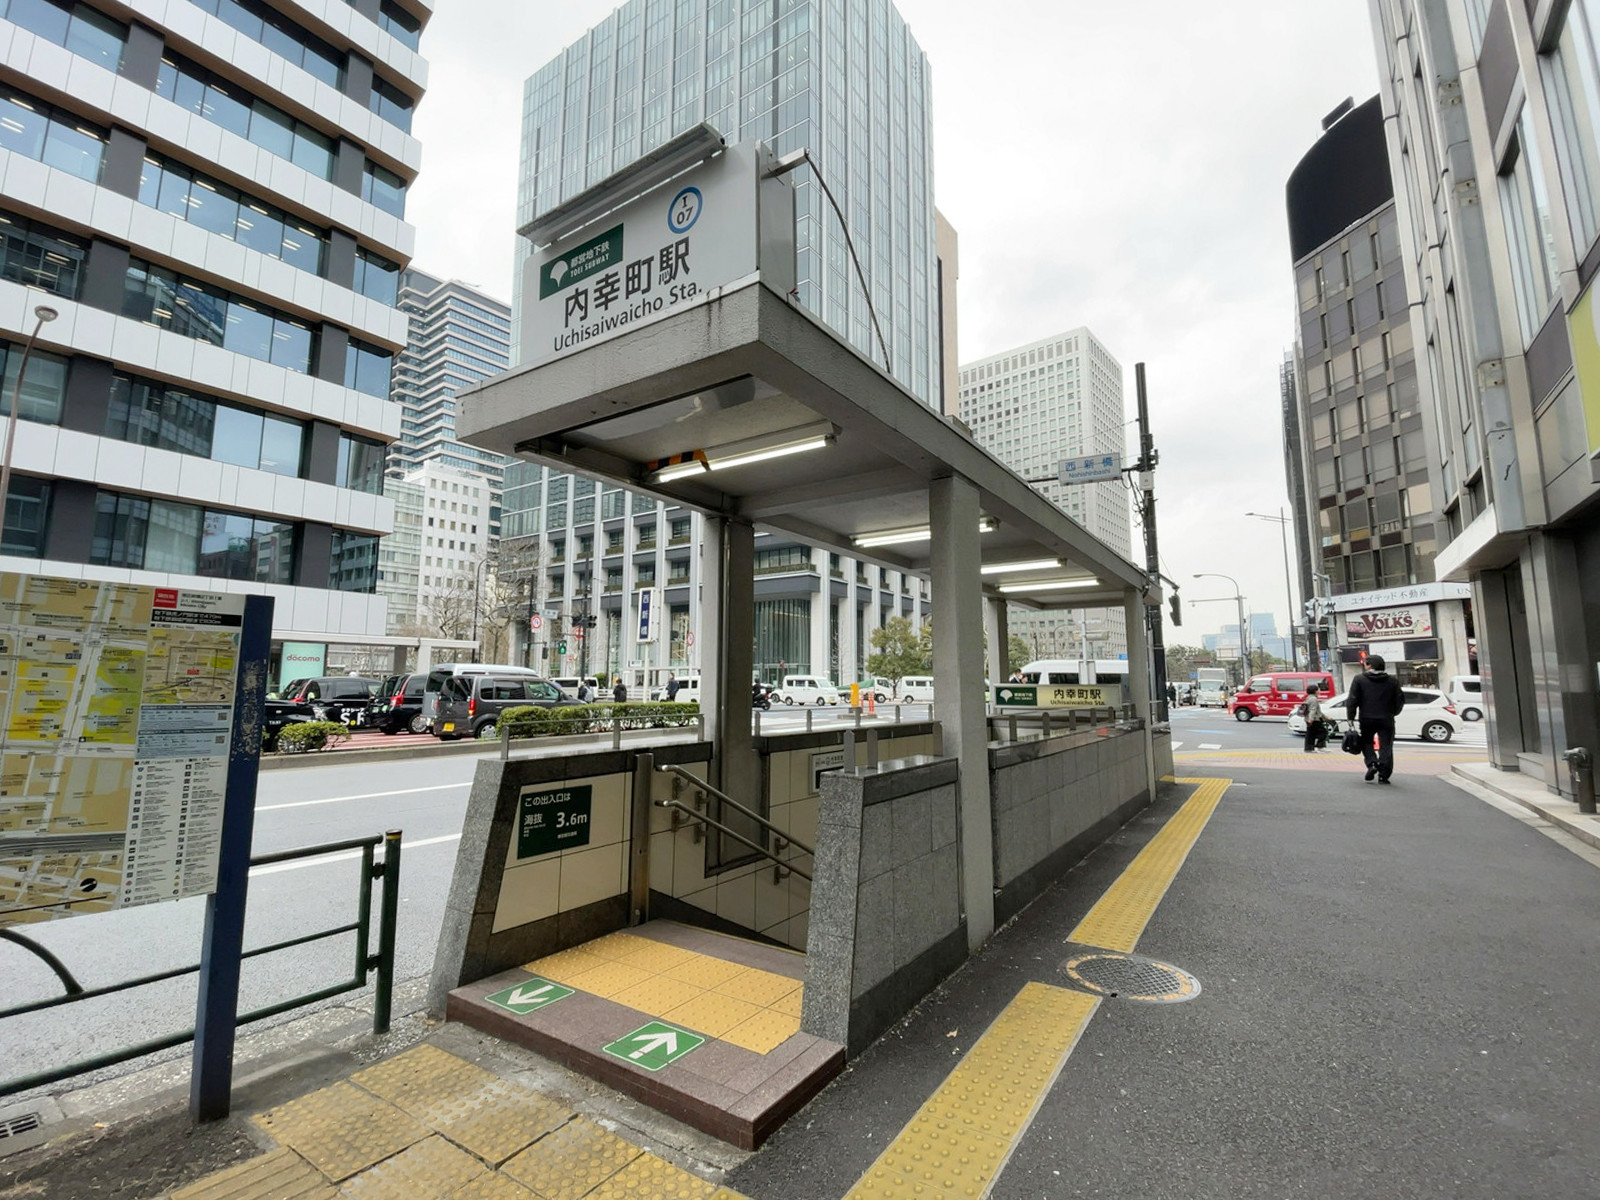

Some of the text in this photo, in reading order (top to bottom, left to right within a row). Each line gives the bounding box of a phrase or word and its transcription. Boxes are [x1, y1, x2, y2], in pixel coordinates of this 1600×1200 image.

[682, 197, 688, 207] I
[677, 207, 693, 225] 07
[570, 240, 610, 266] 都営地下鉄
[570, 254, 609, 277] TOEI SUBWAY
[564, 236, 690, 328] 内幸町駅
[554, 281, 702, 352] Uchisaiwaicho Sta.
[1351, 588, 1429, 605] ユナイテッド不動産
[1380, 610, 1410, 618] フォルクス
[1360, 613, 1413, 633] VOLKS
[286, 654, 321, 662] docomo
[1054, 689, 1102, 699] 内幸町駅
[525, 793, 571, 807] この出入口は
[524, 813, 543, 825] 海抜
[556, 811, 588, 828] 3.6m
